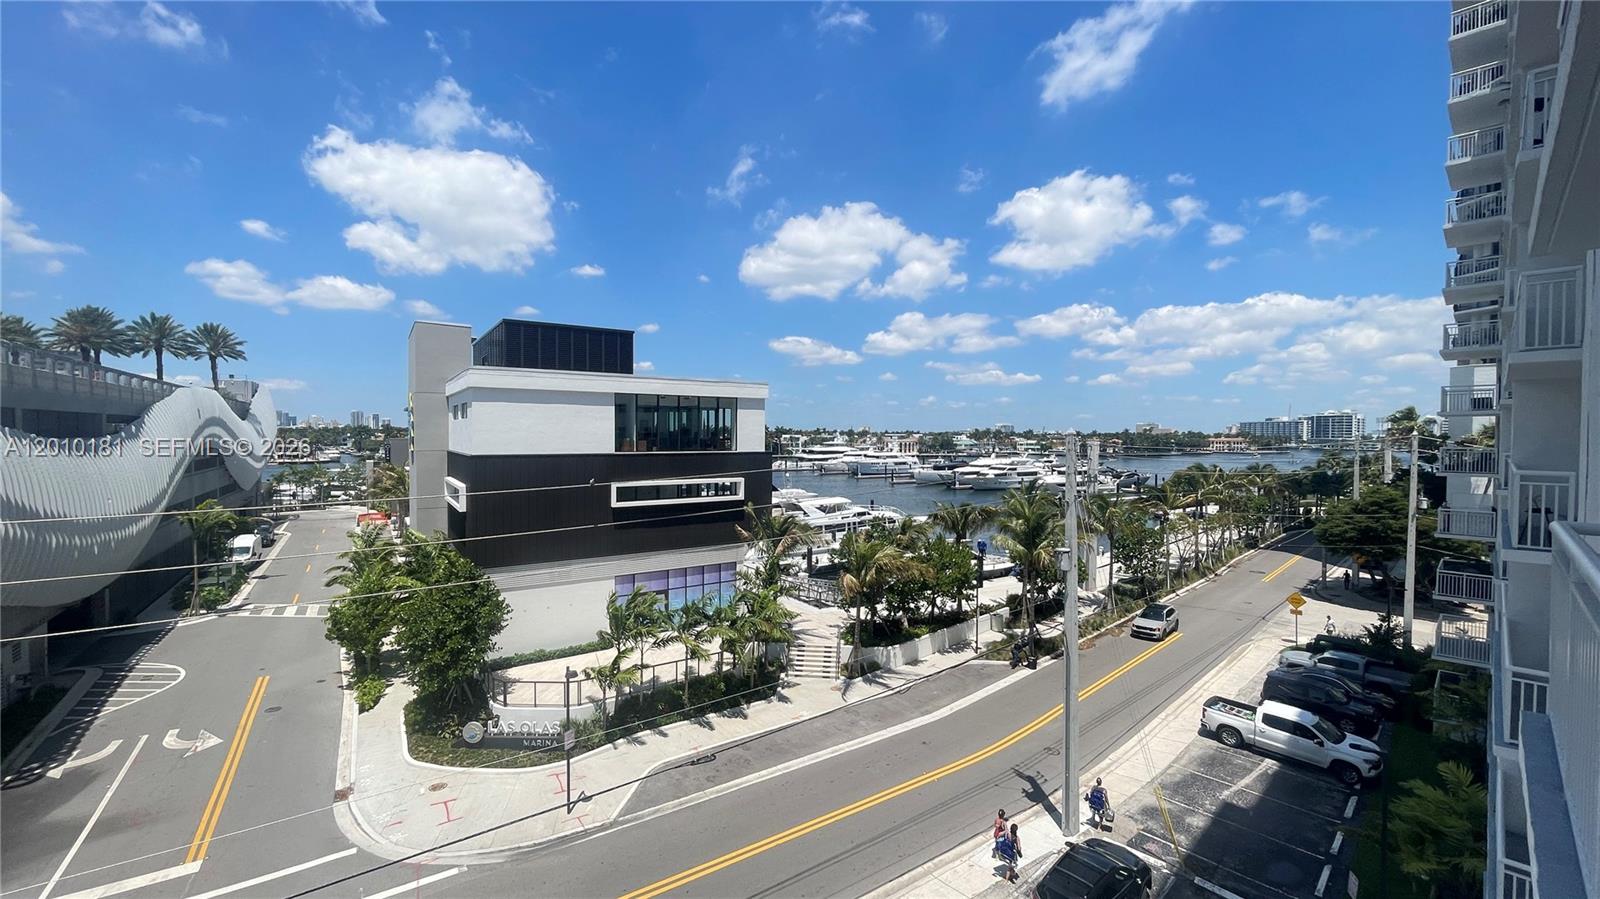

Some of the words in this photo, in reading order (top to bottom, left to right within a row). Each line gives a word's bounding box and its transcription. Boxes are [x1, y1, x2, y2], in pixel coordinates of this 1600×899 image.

[487, 720, 515, 734] LAS
[520, 720, 561, 734] OLAS
[523, 739, 558, 747] MARINA
